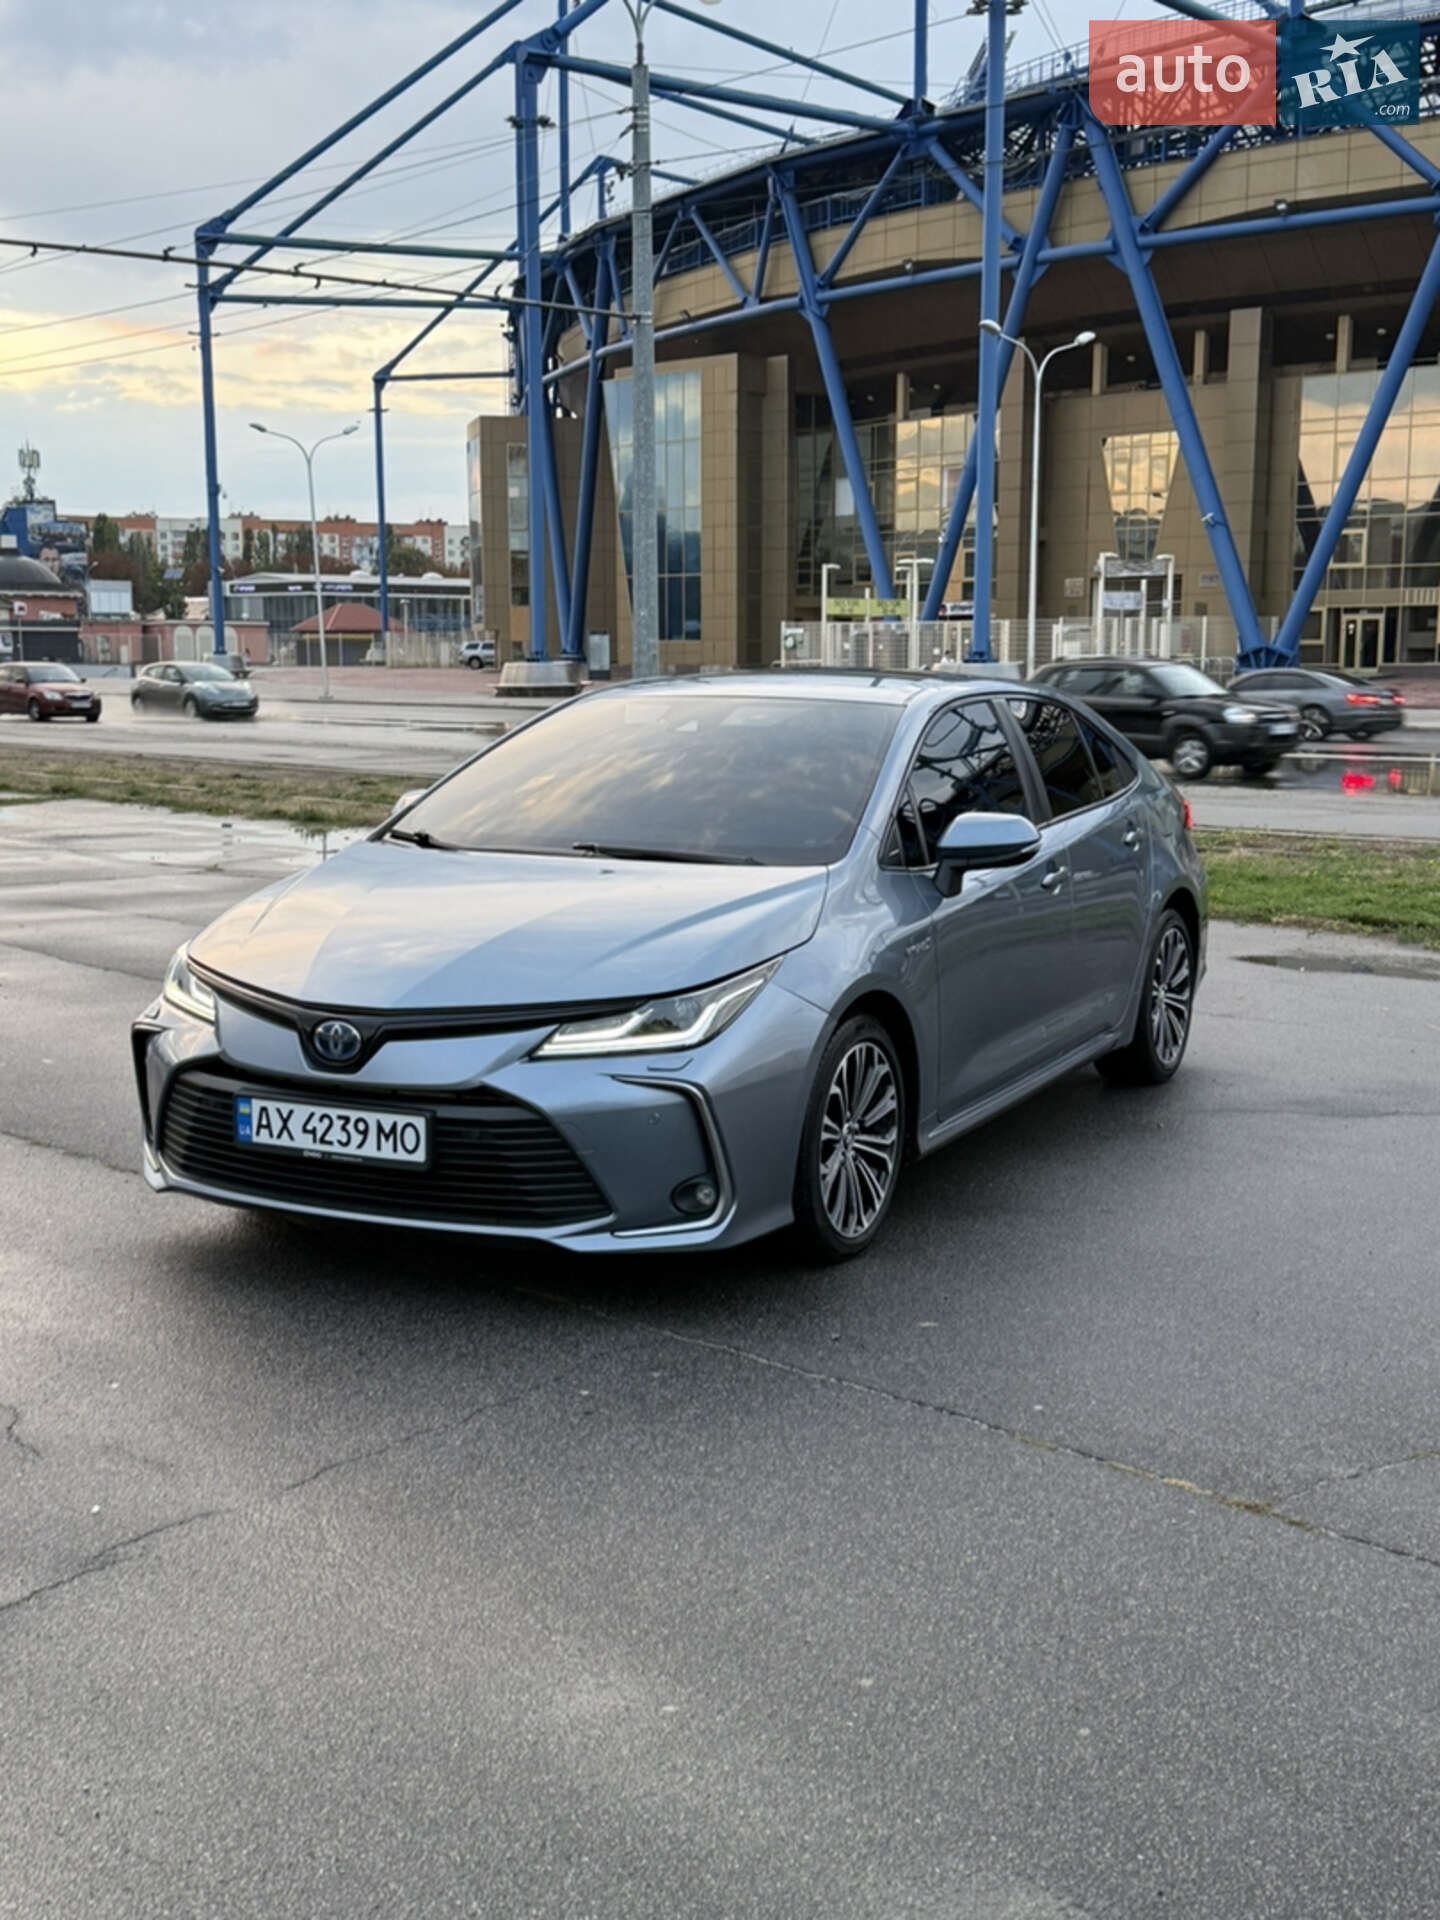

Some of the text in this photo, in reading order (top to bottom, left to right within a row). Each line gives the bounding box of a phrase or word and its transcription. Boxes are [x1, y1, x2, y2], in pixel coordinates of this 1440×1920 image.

[255, 1105, 422, 1155] AX 4239 MO
